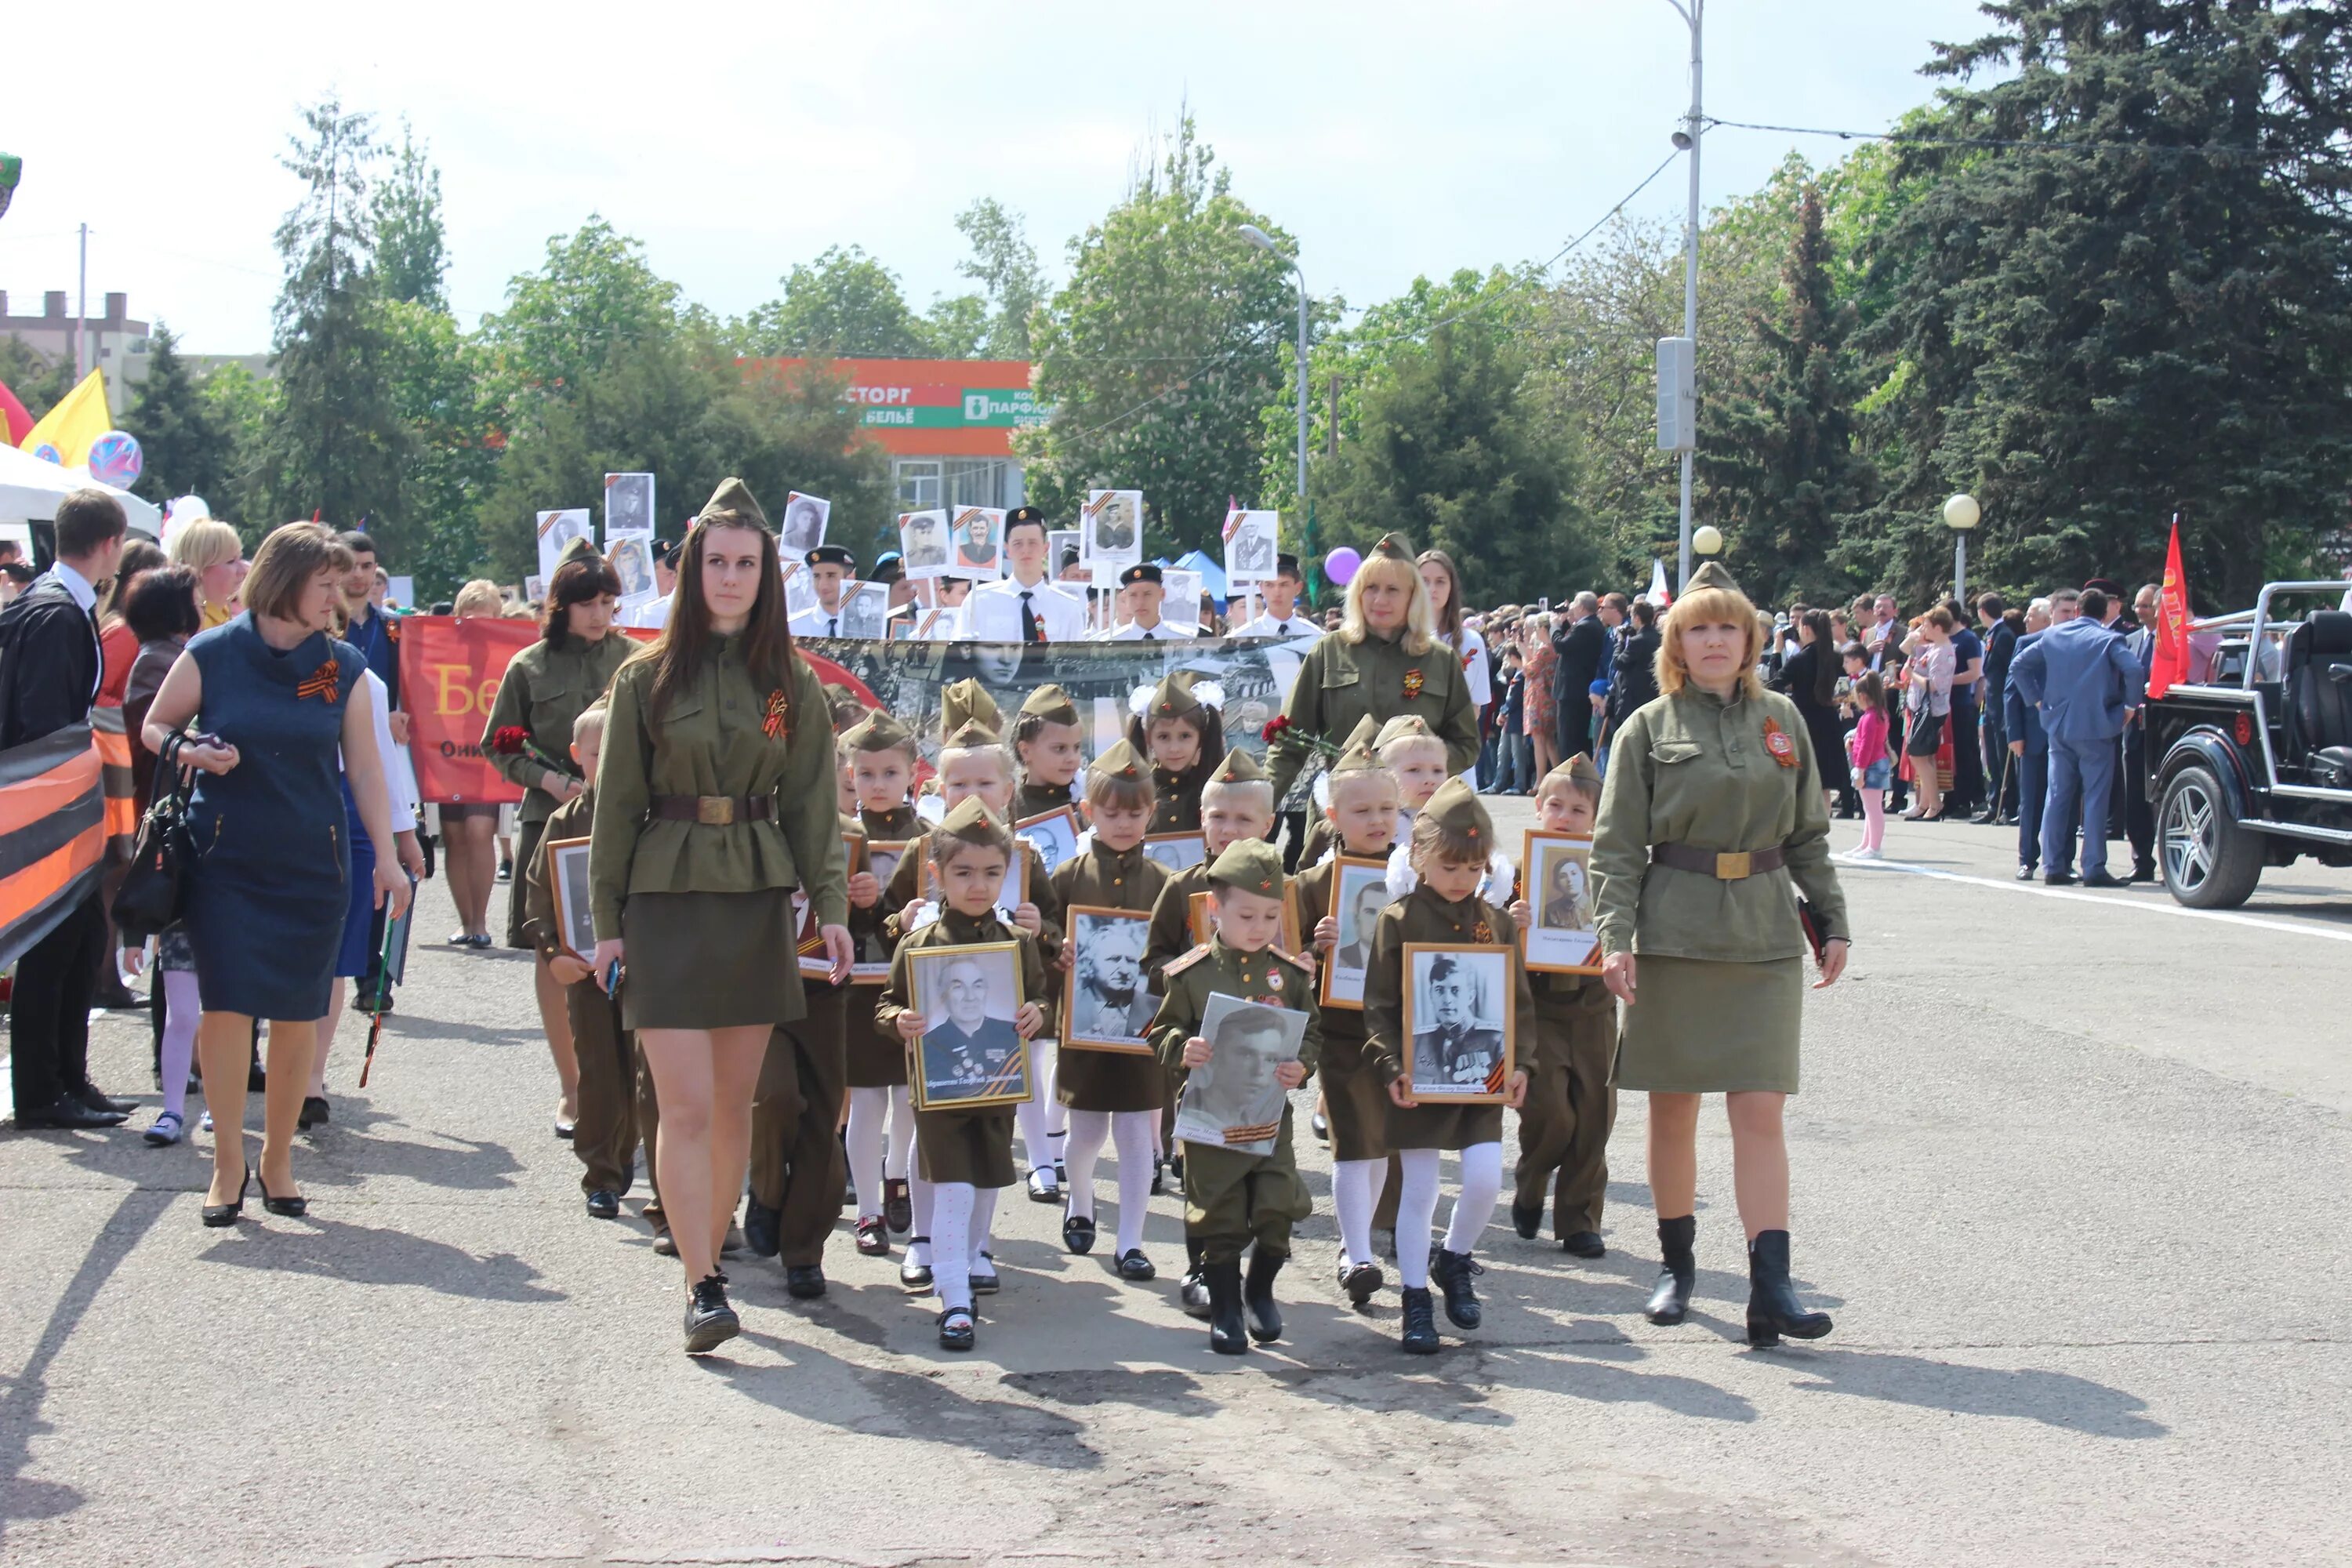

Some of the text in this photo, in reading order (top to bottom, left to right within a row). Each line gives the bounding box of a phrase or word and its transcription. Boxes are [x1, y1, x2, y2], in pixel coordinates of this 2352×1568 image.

[834, 386, 912, 404] СТОРГ
[866, 407, 914, 424] БЕЛЬЁ
[433, 663, 502, 717] Бе
